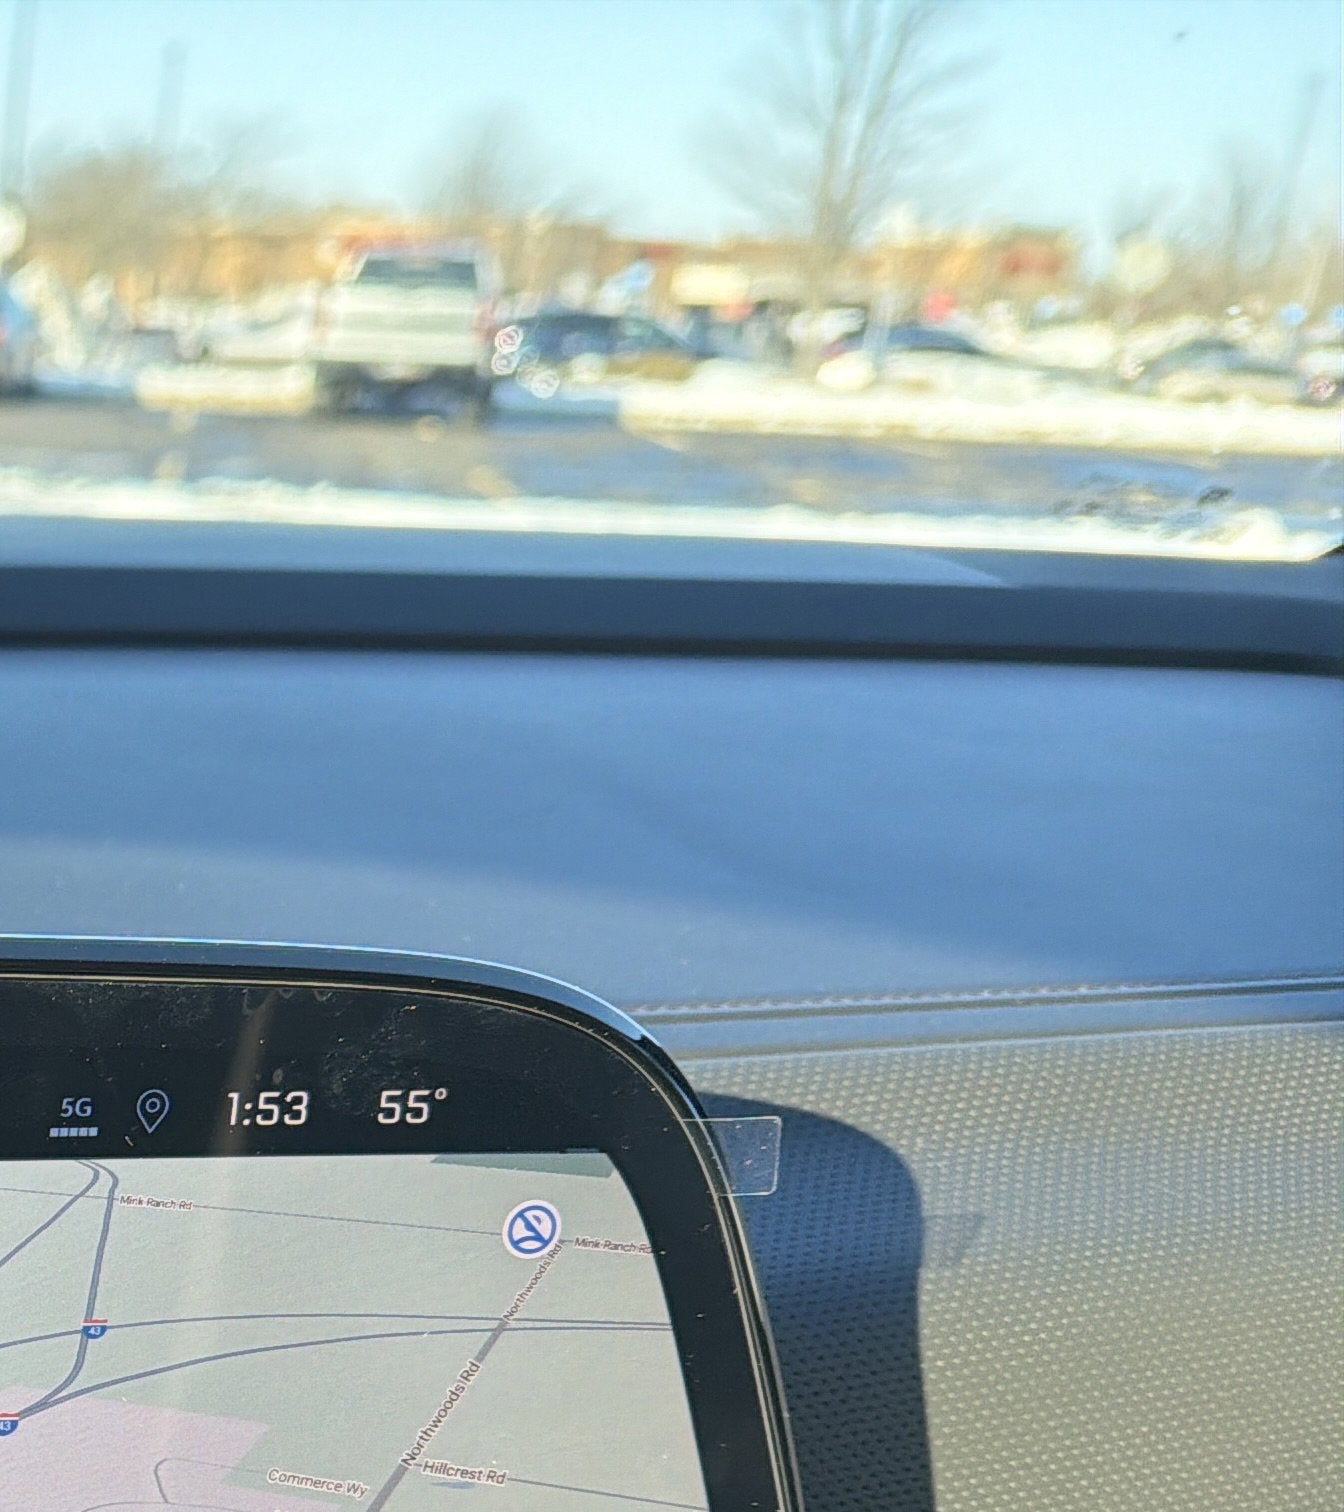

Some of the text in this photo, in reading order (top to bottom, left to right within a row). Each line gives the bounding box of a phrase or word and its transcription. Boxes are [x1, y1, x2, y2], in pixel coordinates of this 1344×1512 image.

[60, 1097, 92, 1117] 5G
[226, 1091, 309, 1126] 1:53
[377, 1087, 448, 1125] 55°
[179, 1201, 192, 1210] Rd
[503, 1243, 563, 1321] Northwoods Rd
[402, 1361, 480, 1467] Northwoods Rd
[268, 1469, 367, 1498] Commerce Wy
[423, 1461, 506, 1484] Hillcrest Rd
